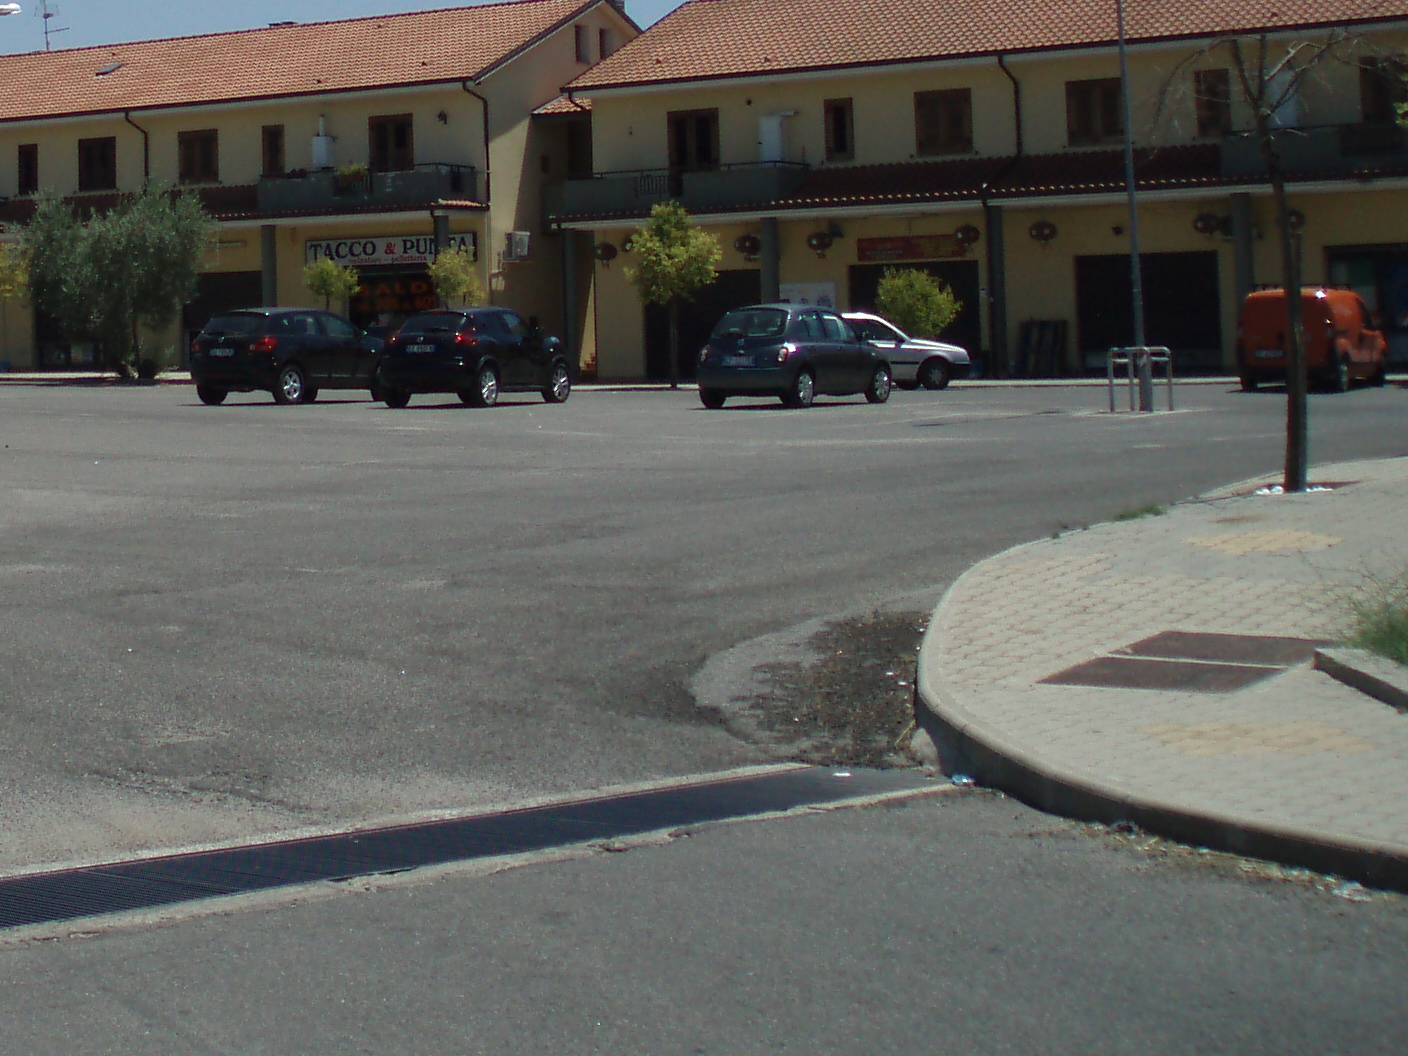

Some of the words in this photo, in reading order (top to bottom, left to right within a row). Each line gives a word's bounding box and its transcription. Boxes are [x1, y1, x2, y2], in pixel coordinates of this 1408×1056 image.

[309, 241, 376, 261] TACCO
[384, 242, 397, 255] &
[357, 281, 429, 296] SALD
